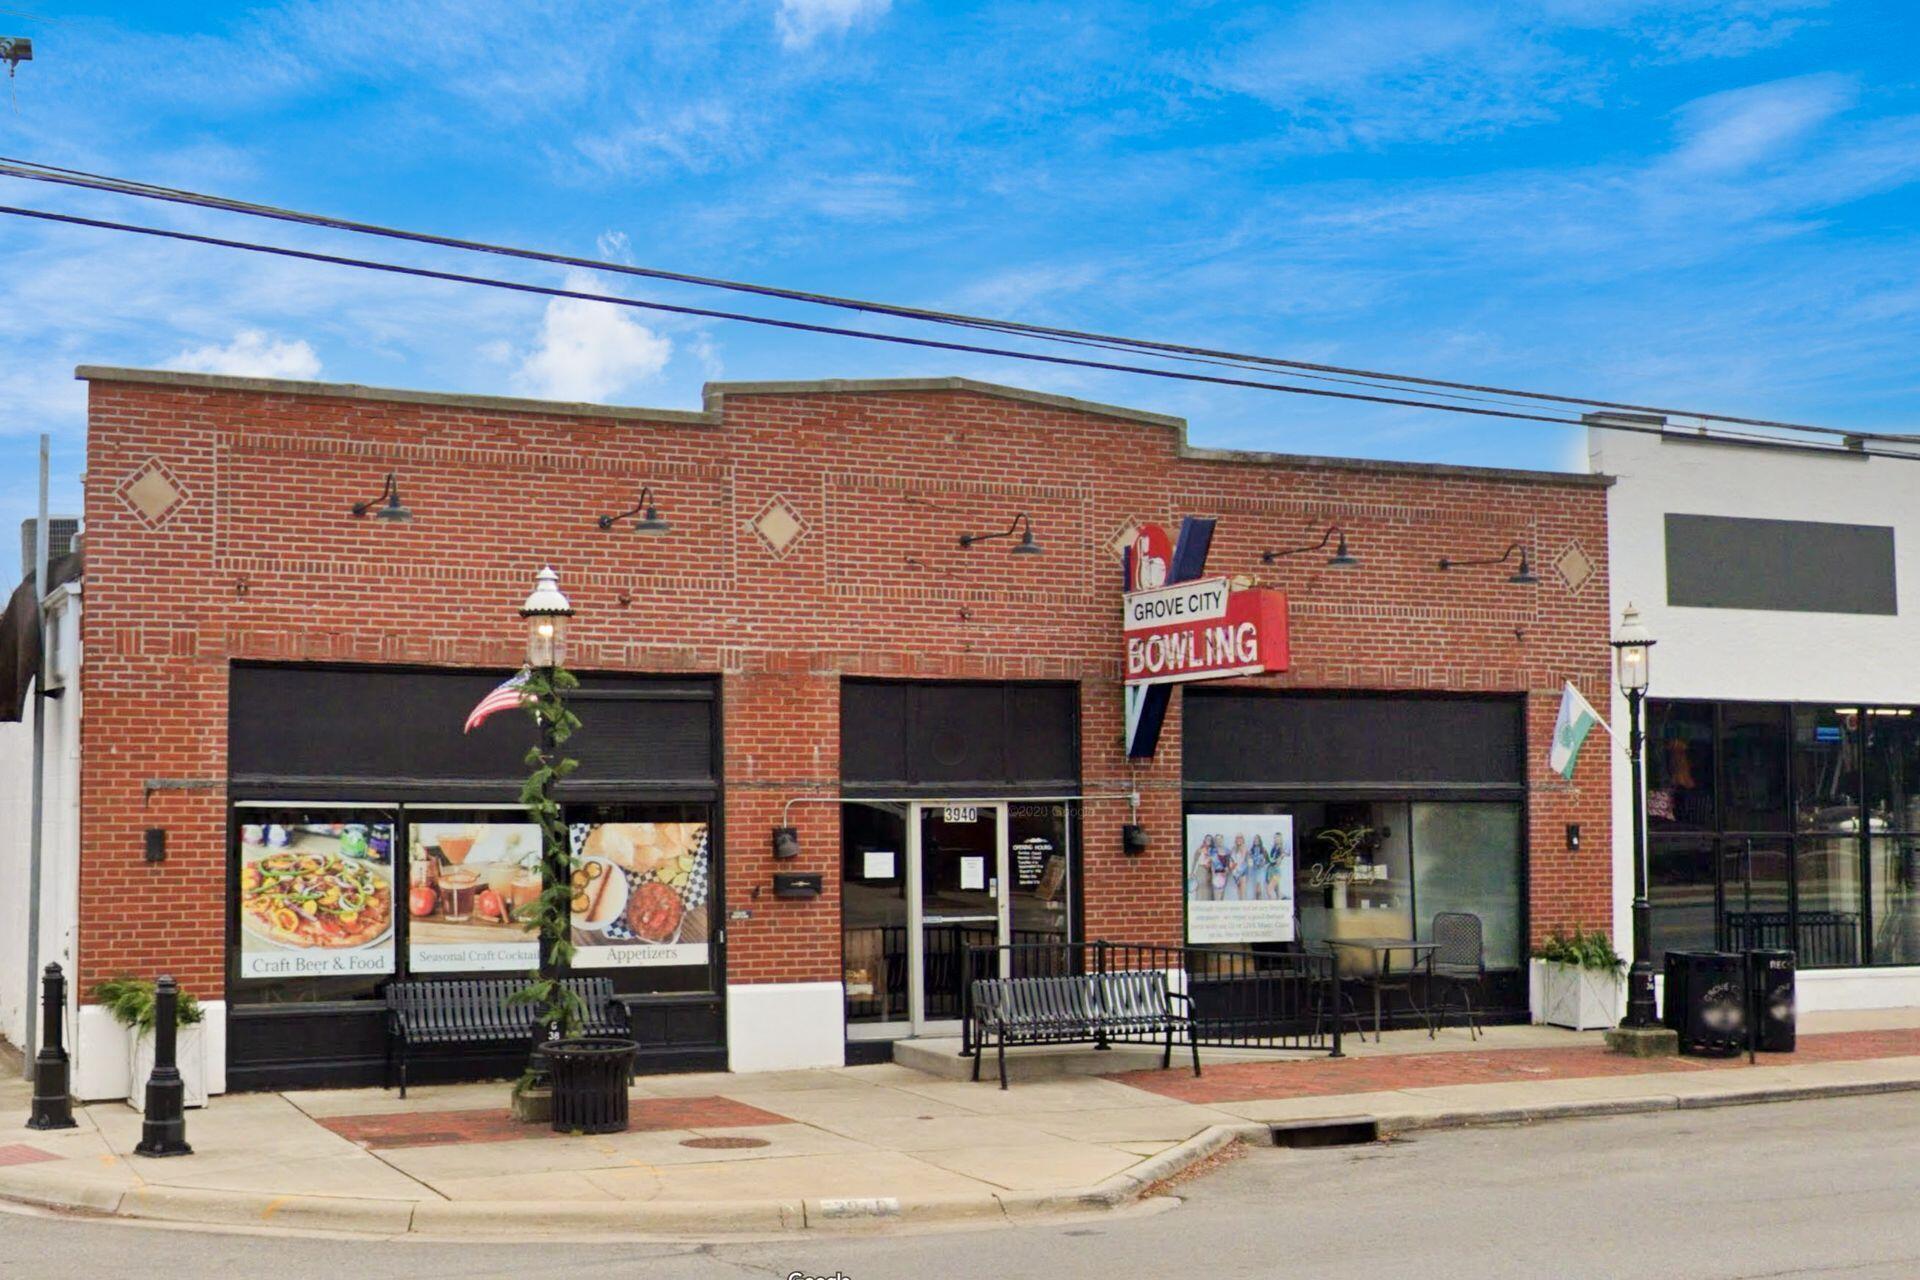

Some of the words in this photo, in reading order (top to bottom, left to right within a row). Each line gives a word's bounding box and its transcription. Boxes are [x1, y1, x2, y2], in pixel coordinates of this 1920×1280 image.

[1134, 597, 1183, 621] GROVE
[1188, 591, 1222, 613] CITY
[1128, 622, 1258, 674] BOWLING
[945, 807, 977, 821] 3940
[252, 958, 290, 973] Craft
[295, 957, 328, 972] Beer
[332, 956, 345, 970] &
[350, 955, 385, 970] Food
[419, 951, 466, 961] Seasonal
[468, 950, 494, 961] Craft
[607, 946, 678, 964] Appetizers
